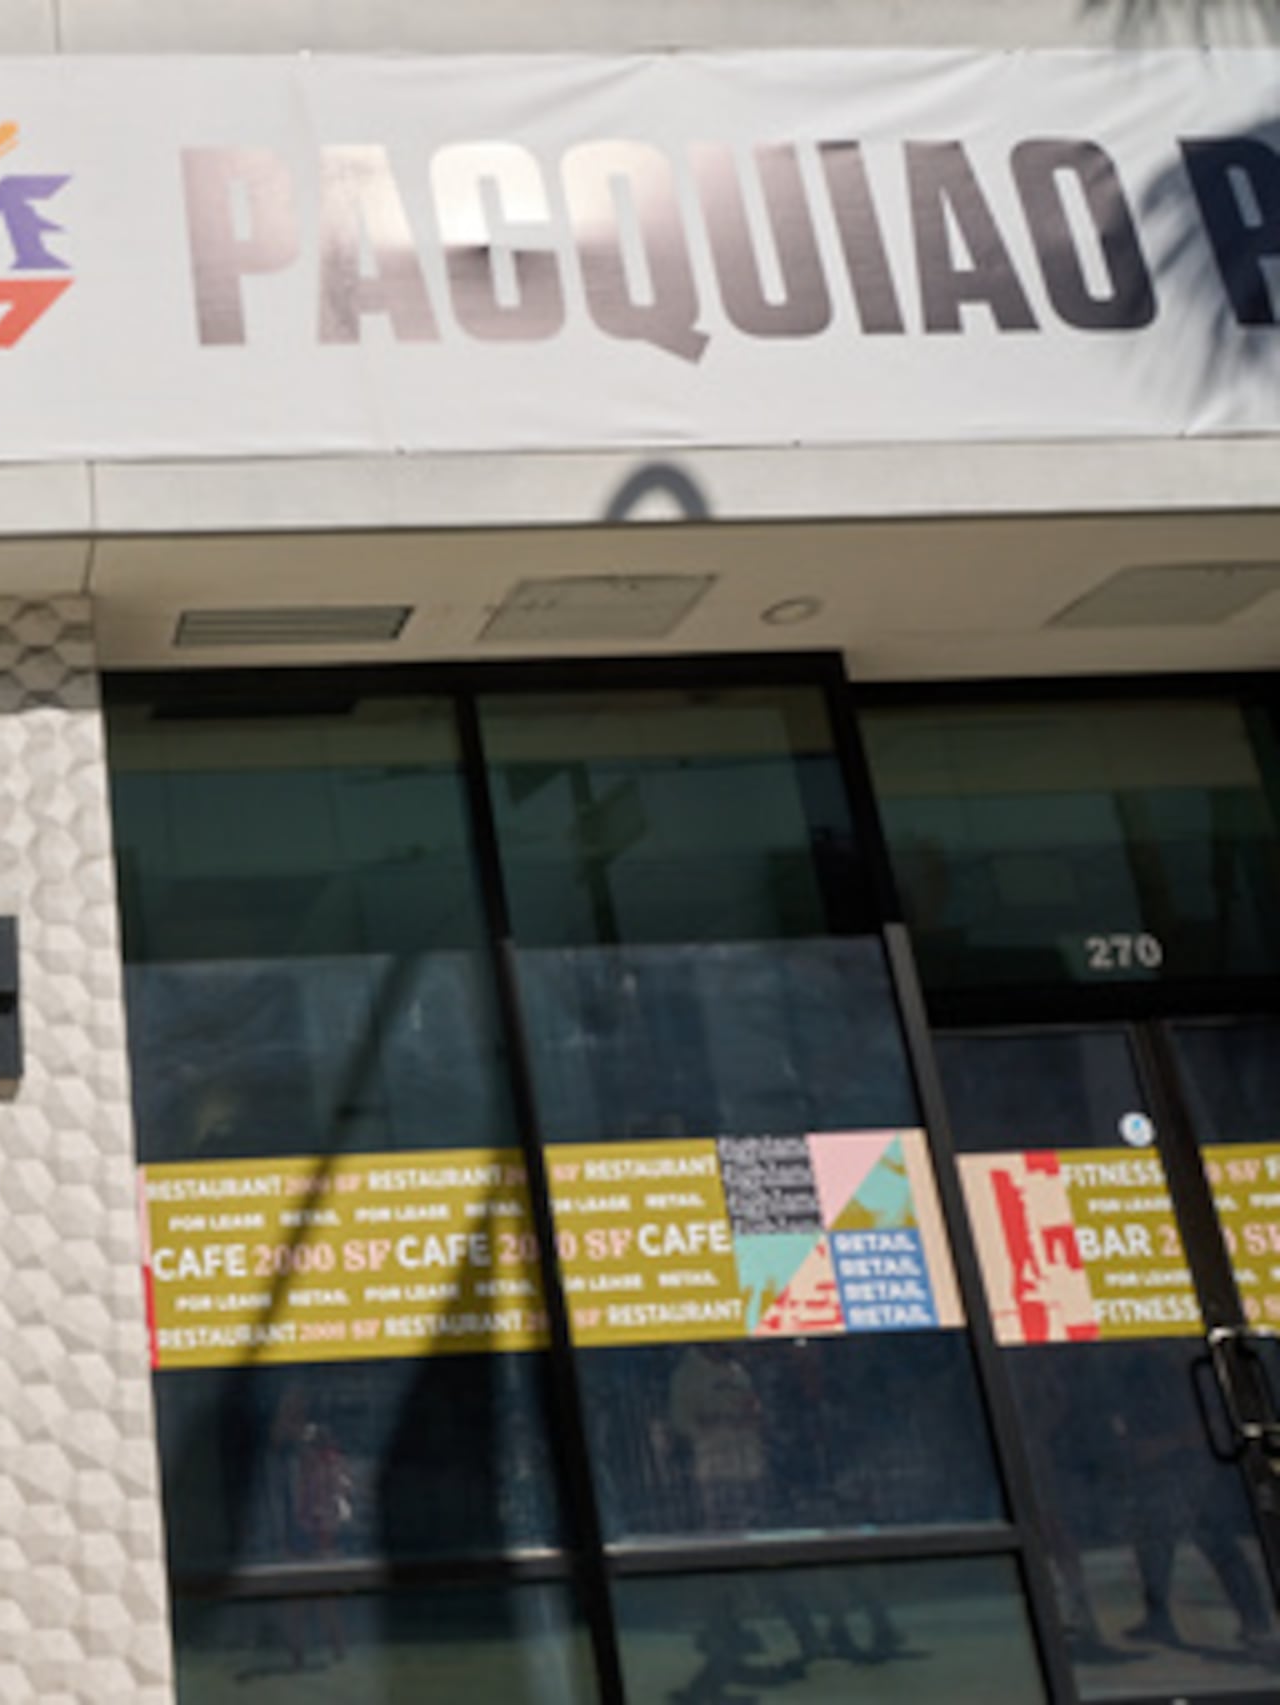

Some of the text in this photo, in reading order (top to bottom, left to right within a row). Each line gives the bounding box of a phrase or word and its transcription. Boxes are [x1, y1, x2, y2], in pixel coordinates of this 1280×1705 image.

[179, 138, 1157, 365] PACQUIAO
[1085, 933, 1163, 968] 270
[146, 1174, 281, 1200] RESTAURANT
[368, 1165, 501, 1190] RESTAURANT
[584, 1155, 716, 1181] RESTAURANT
[152, 1219, 731, 1281] CAFE 2000 SF CAFE 200 SF CAFE
[834, 1232, 916, 1252] RETAIL
[1075, 1223, 1151, 1260] BAR
[839, 1256, 921, 1276] RETAIL
[844, 1280, 926, 1300] RETAIL
[158, 1323, 296, 1350] RESTAURANT
[384, 1309, 522, 1336] RESTAURANT
[607, 1299, 742, 1326] RESTAURANT
[848, 1304, 931, 1326] RETAIL
[1093, 1294, 1202, 1323] FITNESS
